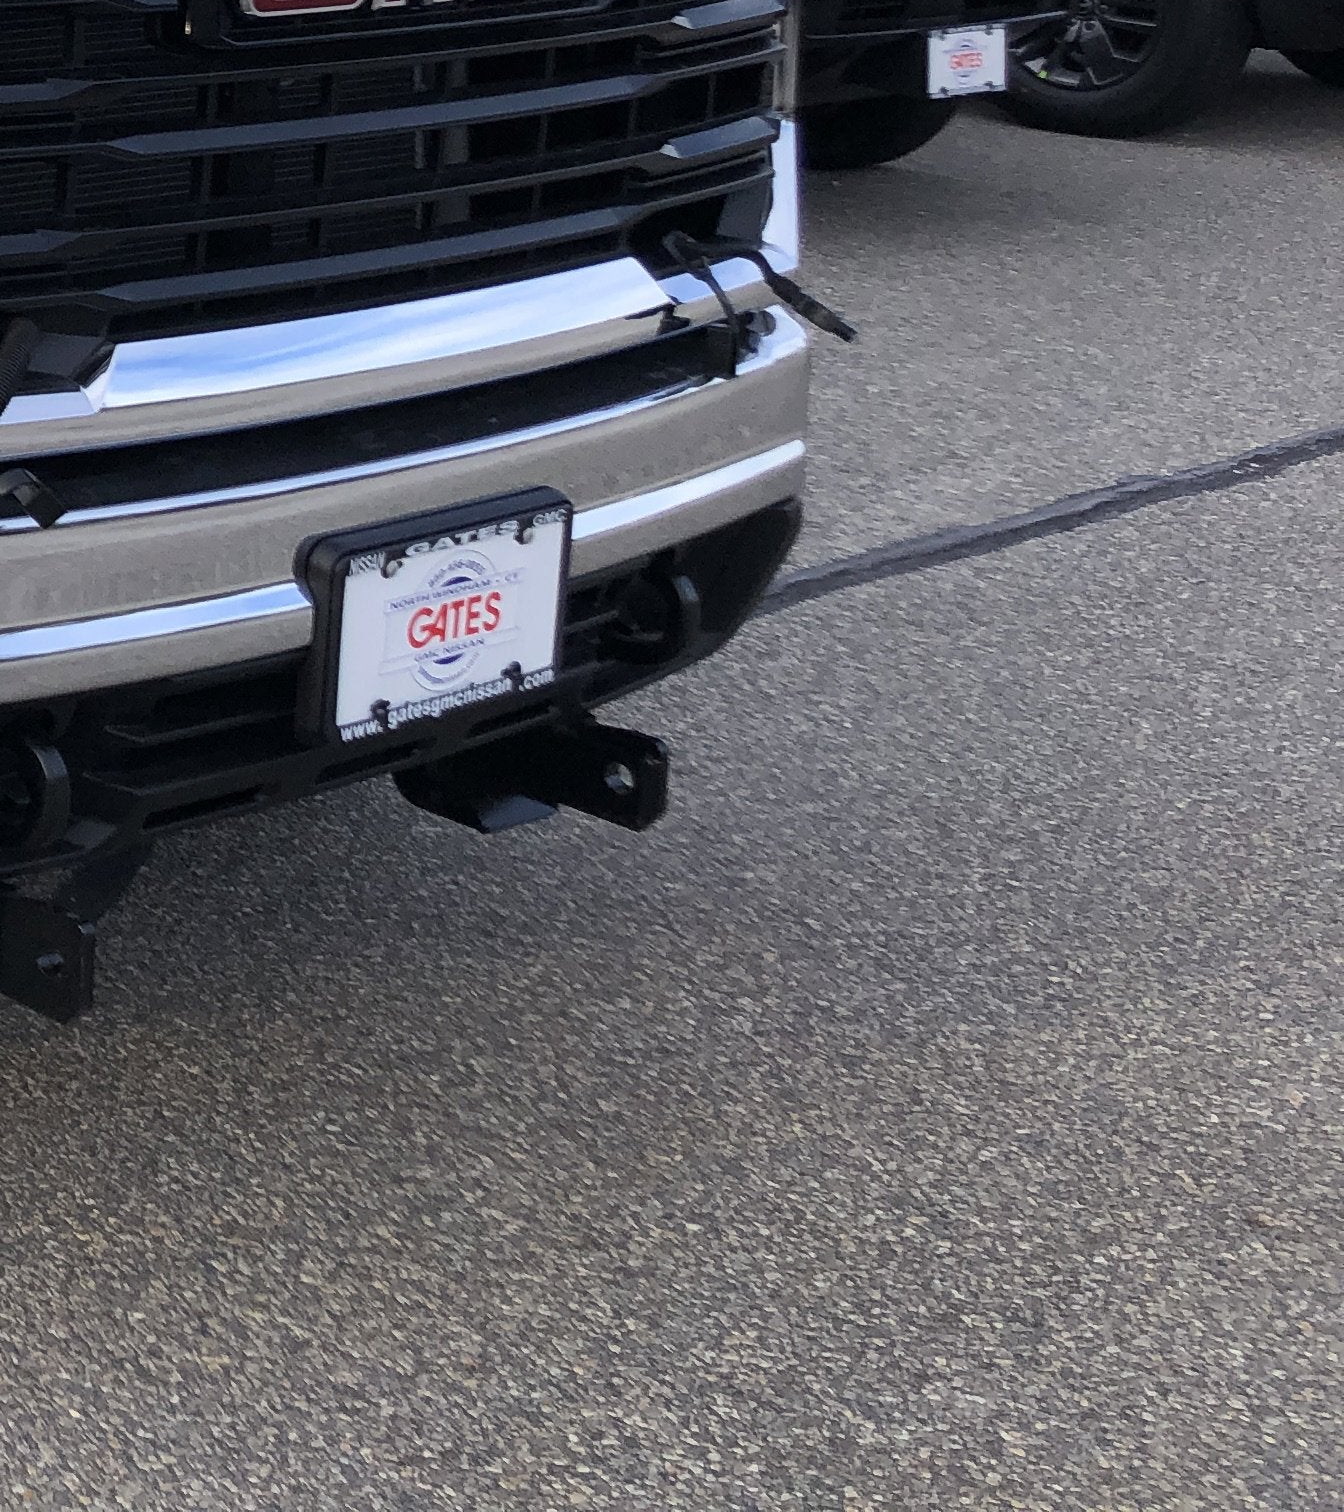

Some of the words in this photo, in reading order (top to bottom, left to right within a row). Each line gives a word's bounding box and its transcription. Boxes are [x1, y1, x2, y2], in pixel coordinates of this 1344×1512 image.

[950, 53, 982, 70] GATES
[405, 521, 519, 557] GATES
[533, 509, 568, 528] GMC
[407, 591, 501, 648] GATES
[443, 636, 484, 655] NISSAN
